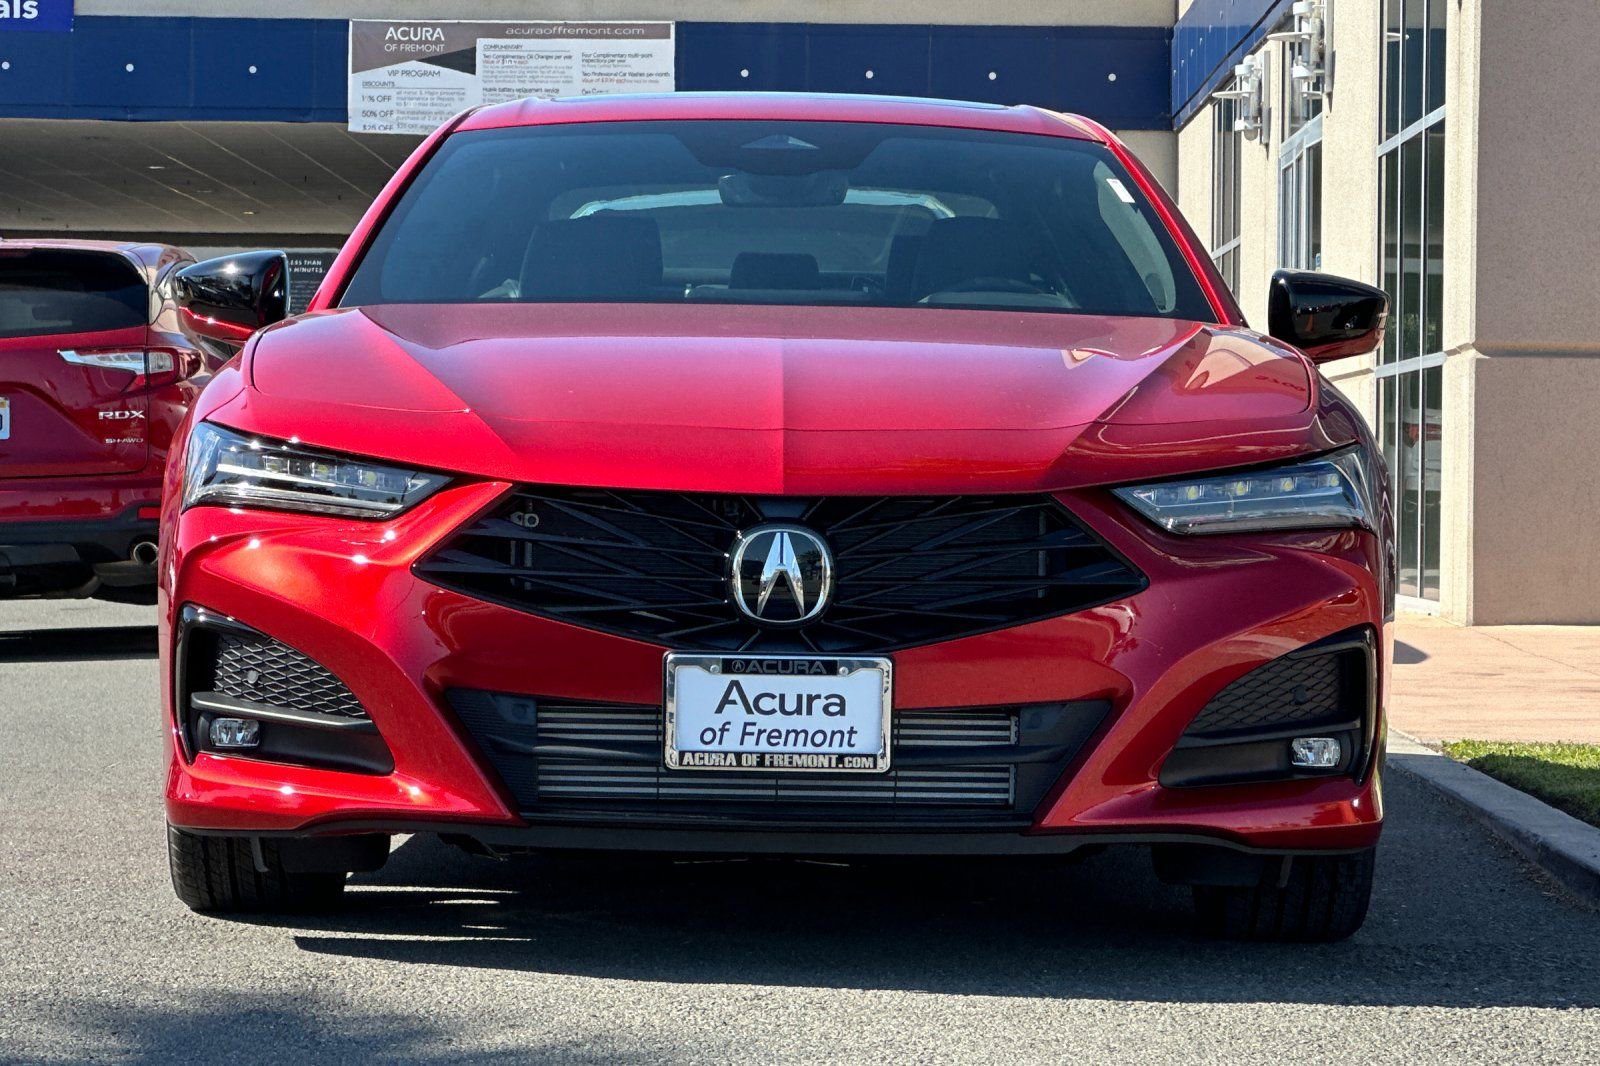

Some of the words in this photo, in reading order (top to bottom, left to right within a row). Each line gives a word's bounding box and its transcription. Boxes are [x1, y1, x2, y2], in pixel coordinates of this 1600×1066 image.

[0, 0, 38, 19] als
[385, 27, 445, 41] ACURA
[505, 26, 645, 35] acuraoffremont.com
[384, 43, 398, 52] OF
[400, 44, 445, 52] FREMONT
[362, 110, 377, 118] 50%
[379, 110, 394, 118] OFF
[98, 410, 145, 420] RDX
[745, 660, 827, 674] ACURA
[714, 679, 847, 717] Acura
[699, 721, 731, 746] of
[739, 721, 858, 748] Fremont
[682, 752, 738, 767] ACURA
[741, 753, 760, 767] OF
[765, 753, 874, 769] FREMONT.COM
